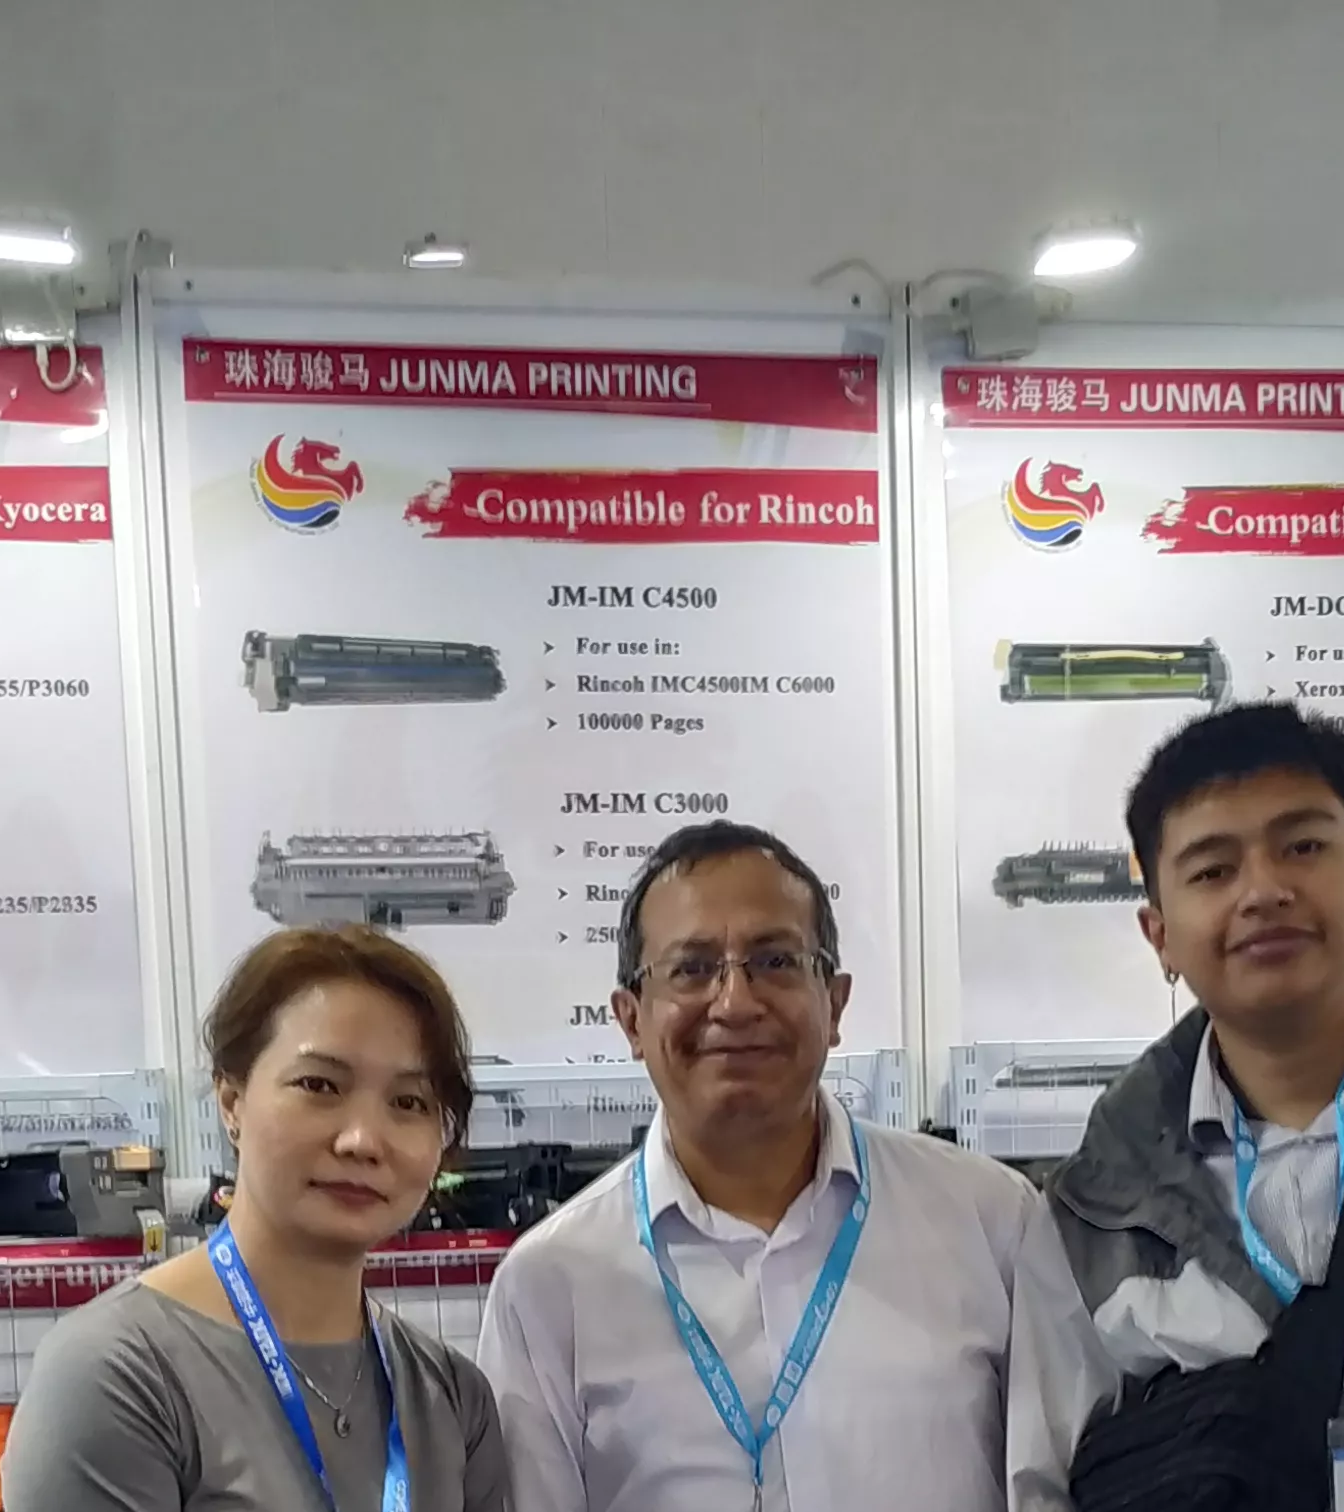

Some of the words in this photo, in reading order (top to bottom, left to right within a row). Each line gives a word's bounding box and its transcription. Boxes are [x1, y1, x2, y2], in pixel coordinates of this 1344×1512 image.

[225, 350, 369, 391] 珠海骏马
[380, 360, 515, 394] JUNMA
[528, 362, 696, 399] PRINTING
[977, 378, 1110, 412] 珠海骏马
[1120, 383, 1246, 412] JUNMA
[478, 490, 685, 530] Compatible
[699, 492, 751, 524] for
[759, 493, 874, 526] Rincoh
[548, 587, 634, 608] JM-IM
[642, 587, 717, 609] C4500
[576, 638, 609, 655] For
[617, 642, 648, 655] use
[655, 638, 680, 655] in:
[1295, 645, 1328, 662] For
[577, 676, 643, 693] Rincoh
[777, 676, 834, 693] C6000
[651, 714, 704, 734] Pages
[560, 794, 646, 814] JM-IM
[654, 793, 728, 814] C3000
[584, 841, 619, 857] For
[570, 1005, 617, 1026] JM-
